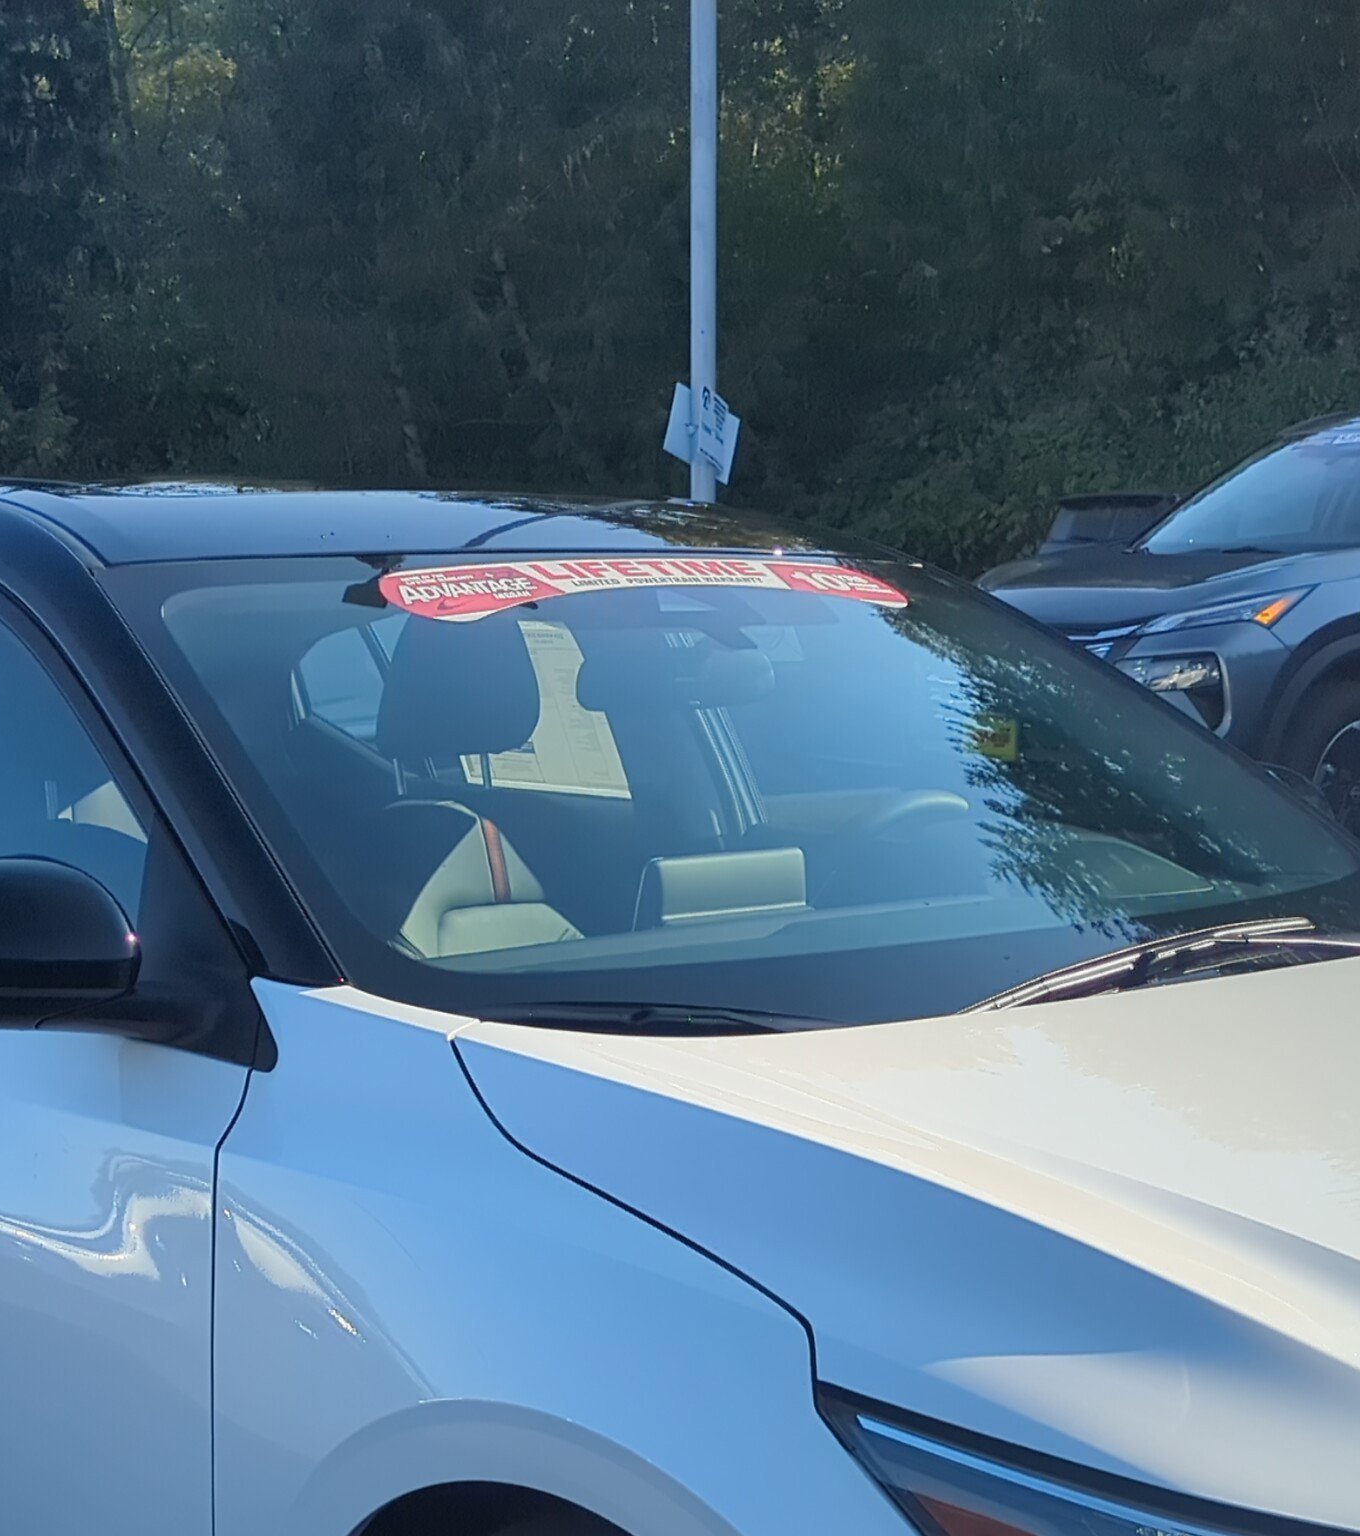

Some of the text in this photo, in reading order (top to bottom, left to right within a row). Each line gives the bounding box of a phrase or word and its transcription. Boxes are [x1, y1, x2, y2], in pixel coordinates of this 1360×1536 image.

[529, 560, 767, 581] LIFETIME
[790, 570, 852, 591] 10
[398, 577, 539, 606] ADVANTAGE
[570, 576, 764, 588] LIMITED POWERTRAIN WARRANTY
[492, 591, 533, 600] NISSAN
